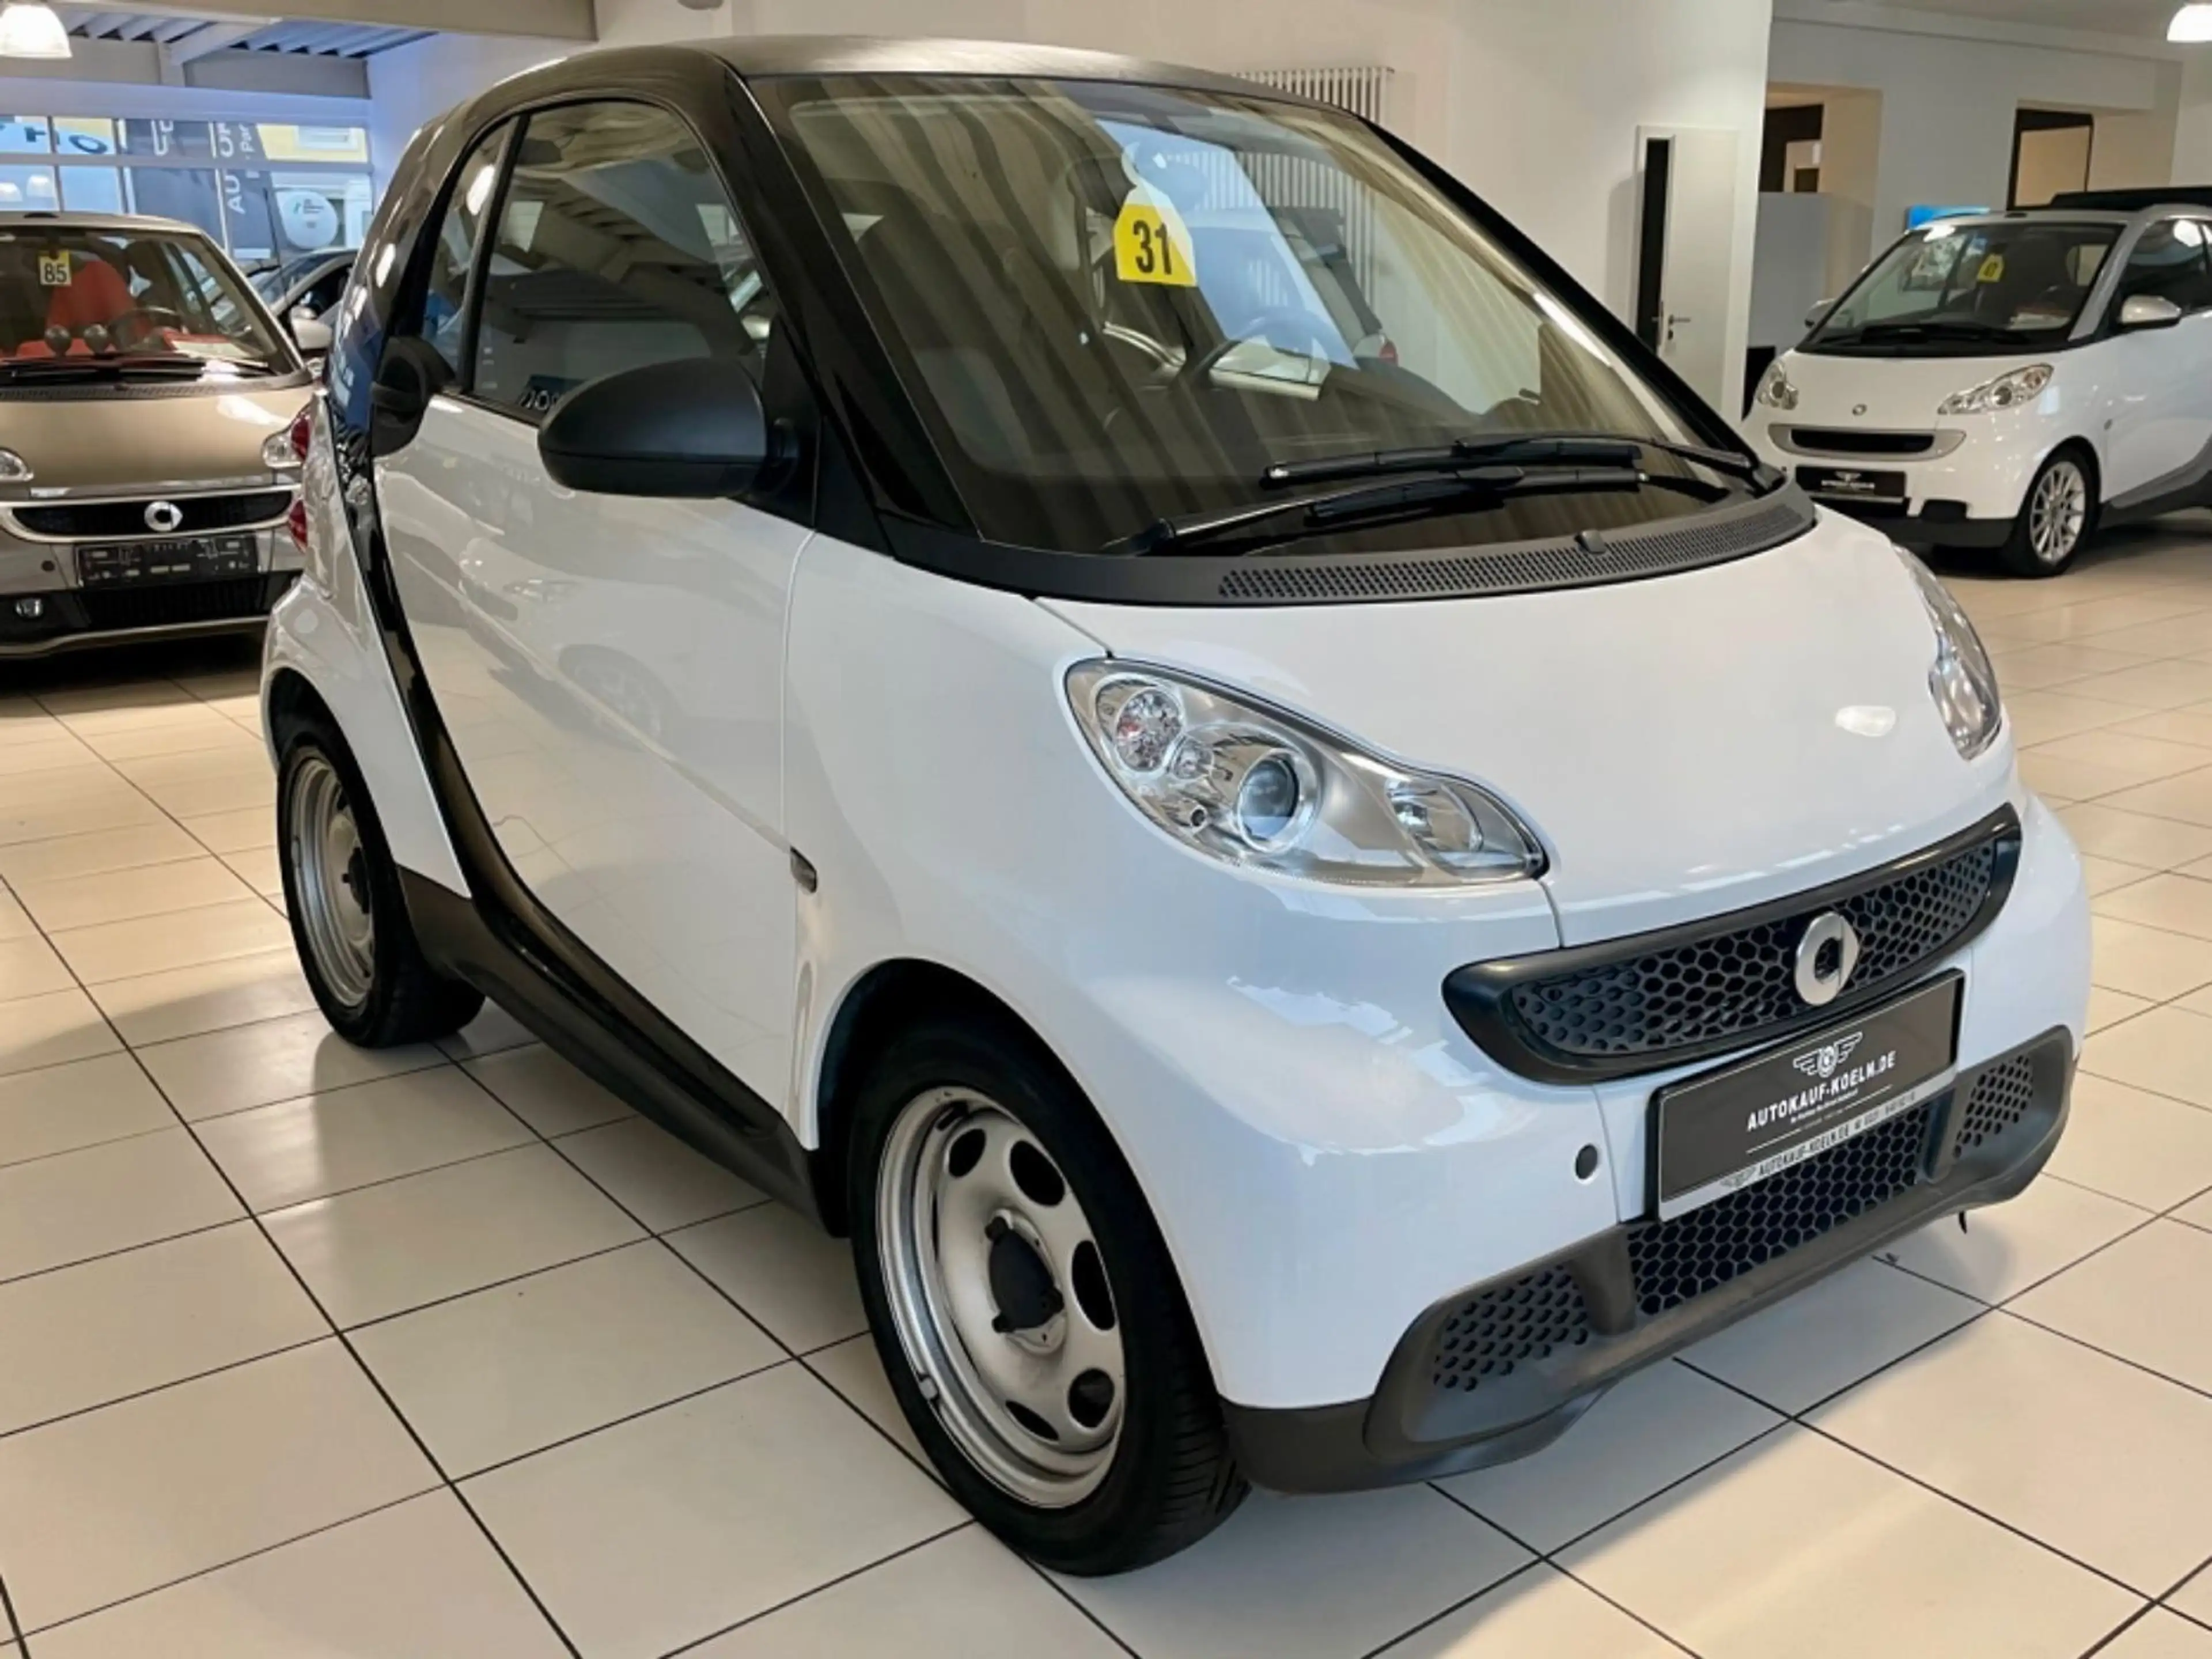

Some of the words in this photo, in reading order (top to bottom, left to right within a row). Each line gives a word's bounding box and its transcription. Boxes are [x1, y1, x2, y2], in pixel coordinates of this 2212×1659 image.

[44, 262, 67, 283] 85
[1133, 219, 1172, 275] 31
[1747, 1050, 1896, 1132] AUTOKAUF-KOELN.DE
